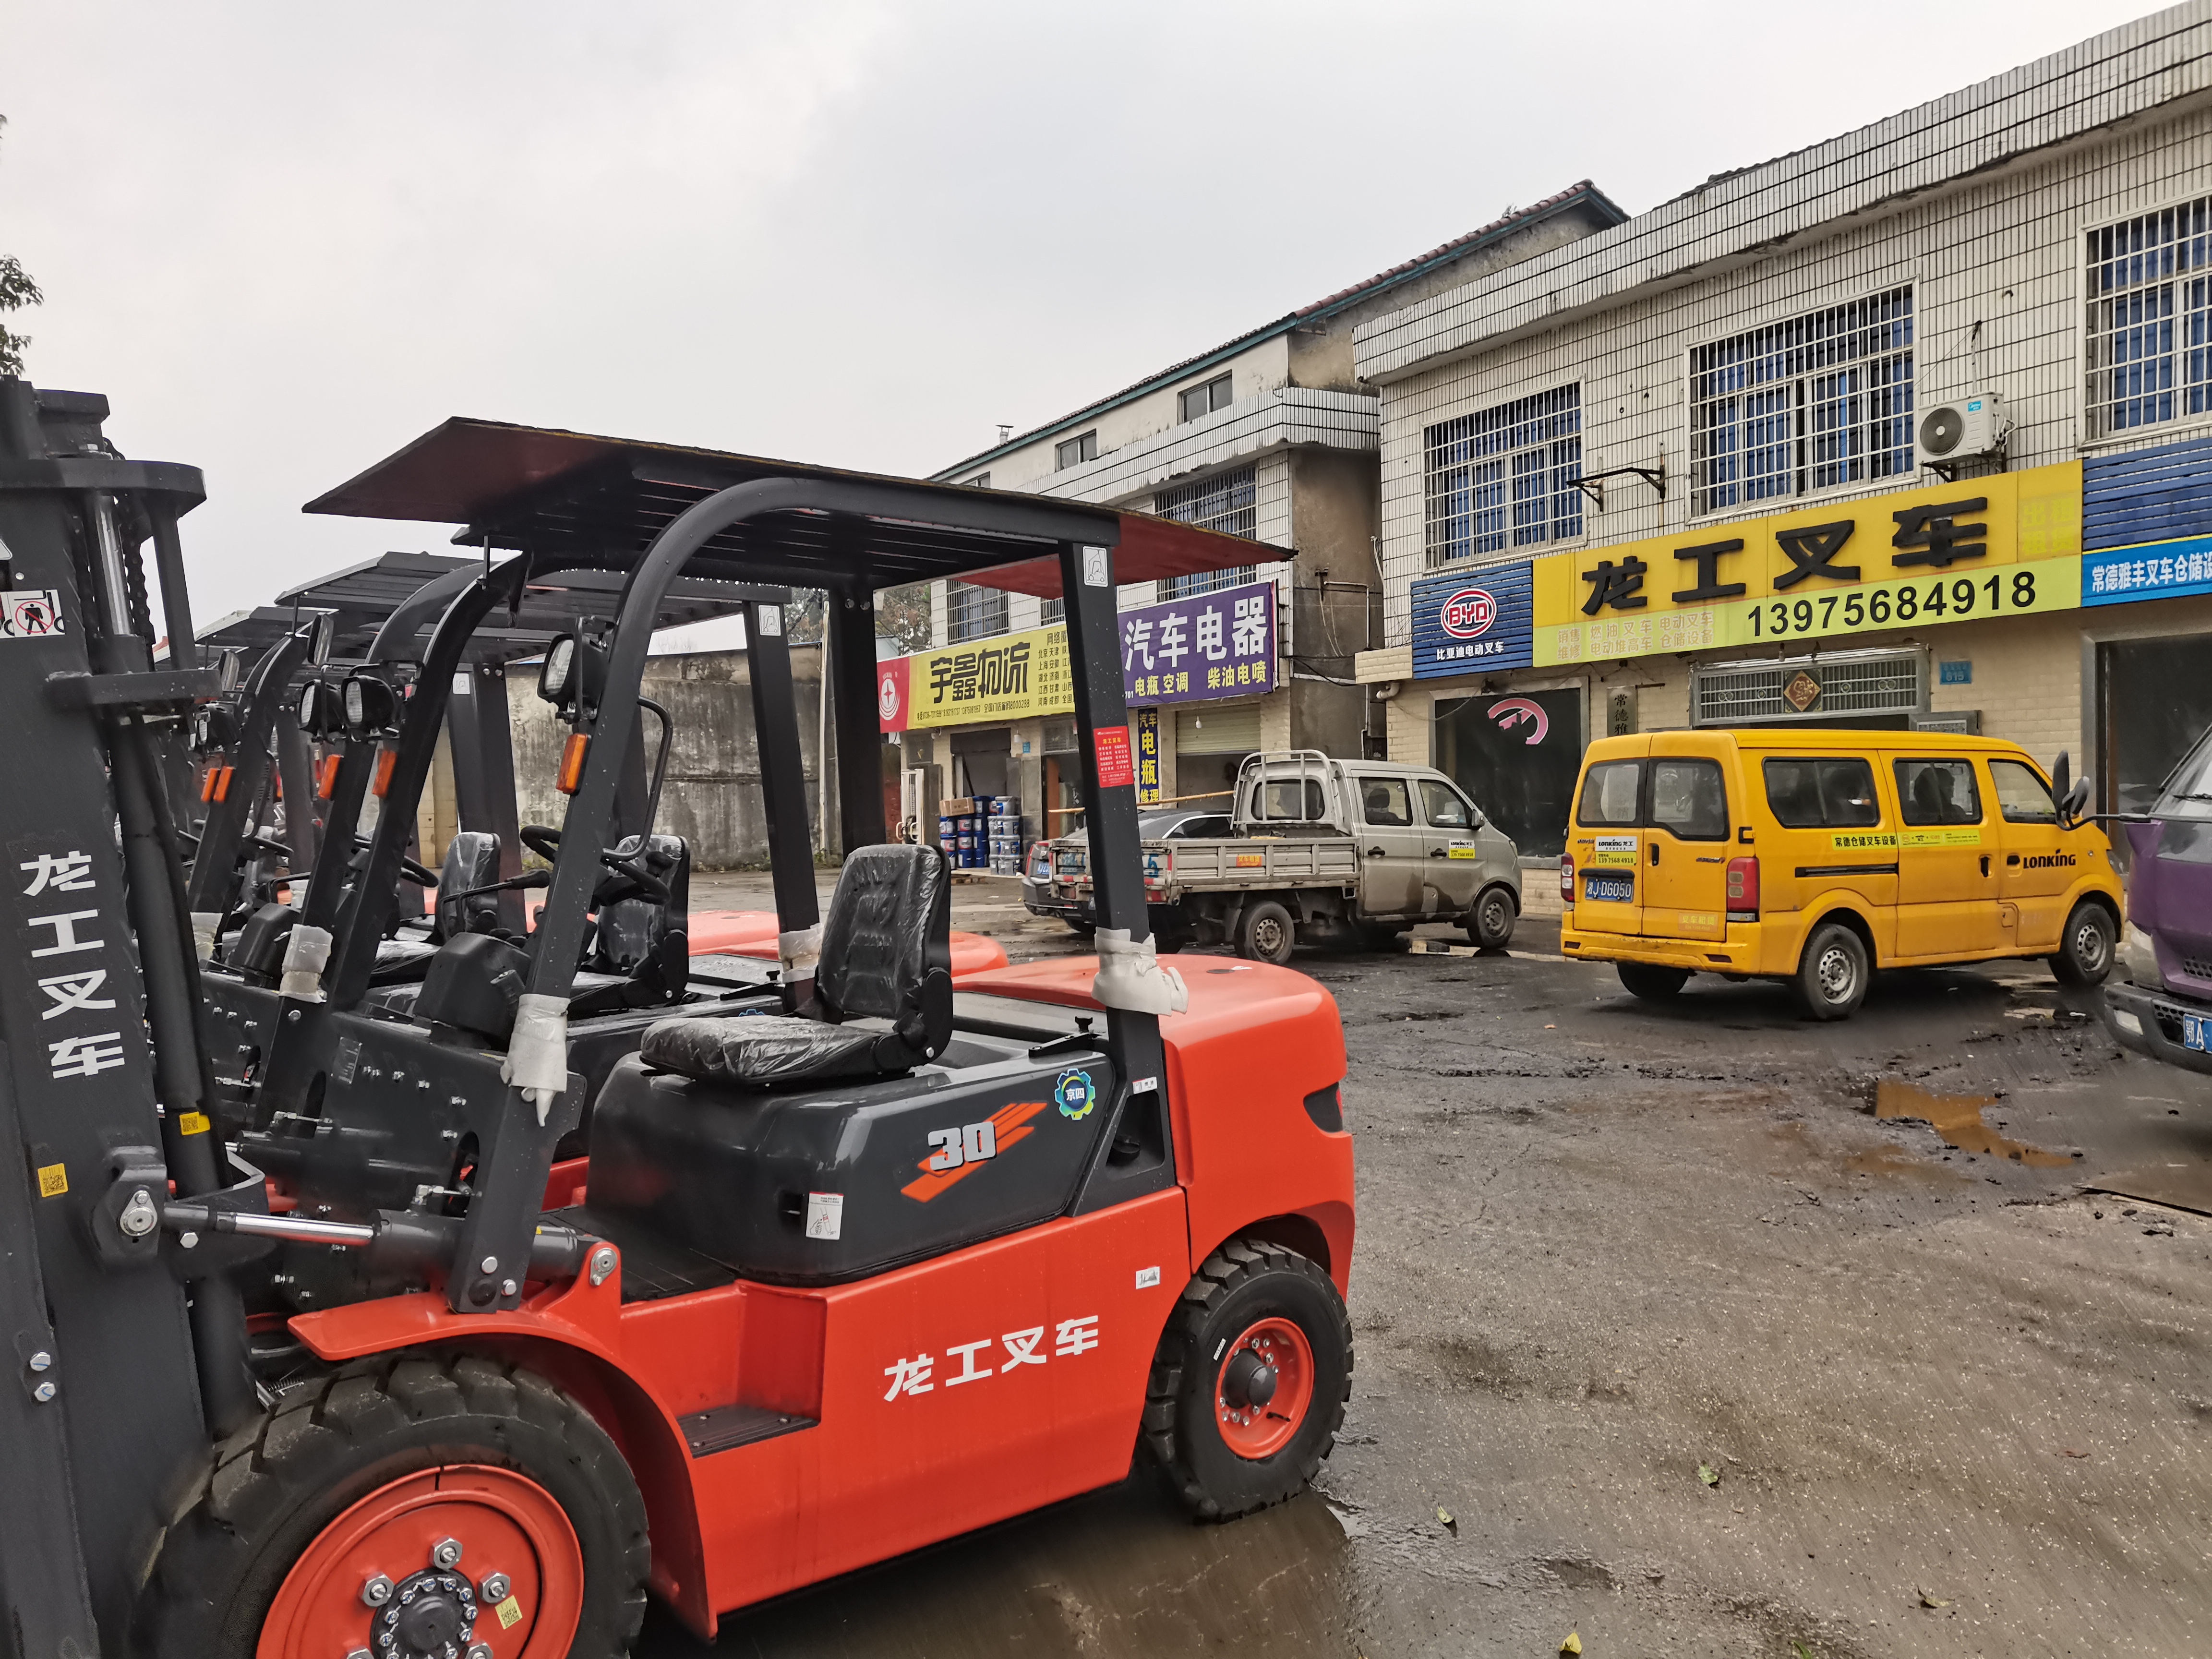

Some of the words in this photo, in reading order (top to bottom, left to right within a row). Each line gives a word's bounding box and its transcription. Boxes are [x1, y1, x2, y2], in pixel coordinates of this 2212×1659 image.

[1581, 497, 1988, 616] 龙工叉车
[1448, 601, 1489, 626] BYD
[1747, 571, 2035, 637] 13975684918
[1125, 596, 1267, 672] 汽车电器
[1557, 628, 1580, 644] 销售
[1590, 619, 1652, 640] 燃油叉车
[1659, 611, 1713, 632] 电动叉车
[1557, 644, 1580, 660] 维修
[1590, 637, 1652, 657] 电动堆高车
[1660, 628, 1713, 649] 仓储设备
[1437, 641, 1504, 661] 比亚迪电动叉车
[930, 642, 1030, 704] 宇鑫物流
[1135, 675, 1159, 697] 电瓶
[1163, 672, 1188, 694] 空调
[1208, 660, 1266, 690] 柴油电喷
[1140, 713, 1157, 728] 汽车
[1141, 729, 1157, 784] 电瓶
[1140, 788, 1159, 803] 修理
[1835, 835, 1896, 847] 常德仓储叉车设备
[20, 850, 125, 1079] 龙工叉车
[1065, 1087, 1085, 1101] 京四
[927, 1121, 997, 1171] 30
[884, 1315, 1098, 1402] 龙工叉车
